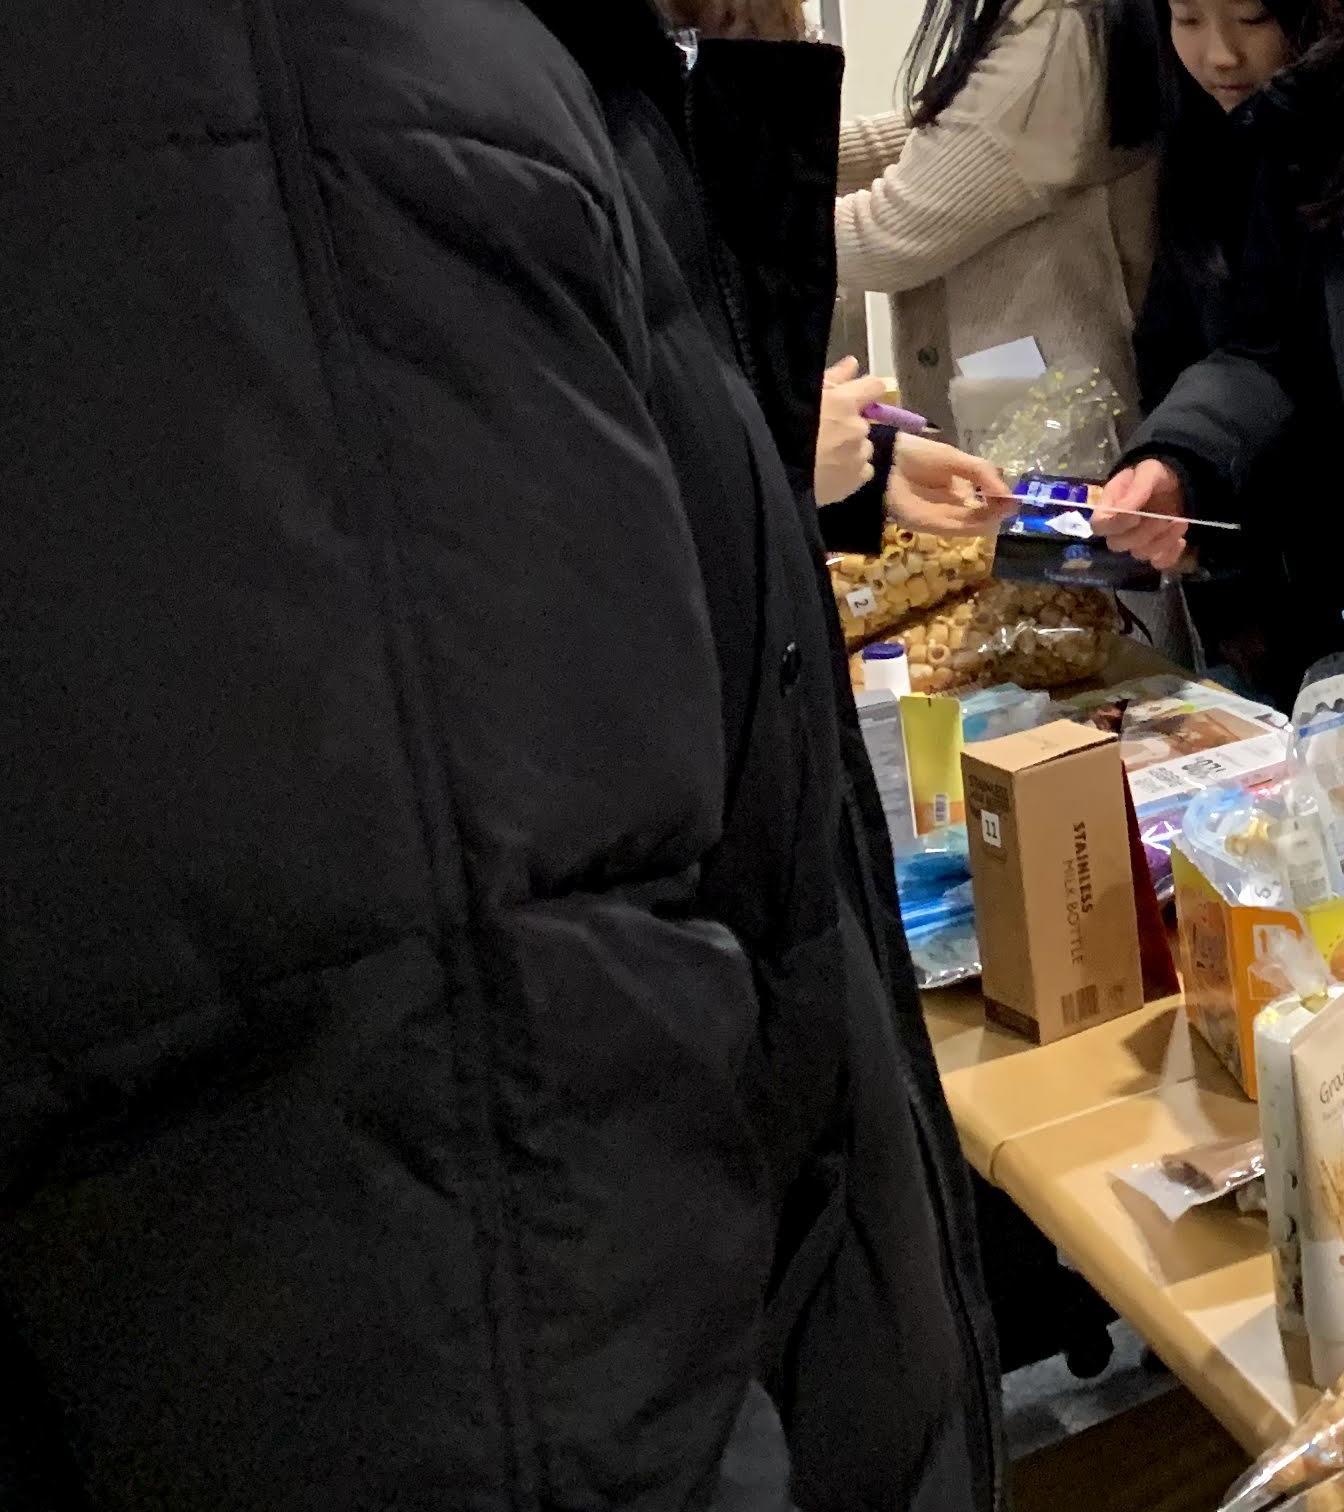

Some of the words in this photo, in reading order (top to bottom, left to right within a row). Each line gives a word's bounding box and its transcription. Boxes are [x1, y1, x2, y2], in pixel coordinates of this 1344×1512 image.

[984, 819, 998, 839] 11
[1062, 858, 1077, 893] MILK
[1072, 821, 1094, 913] STAINLESS
[1066, 899, 1084, 965] BOTTLE
